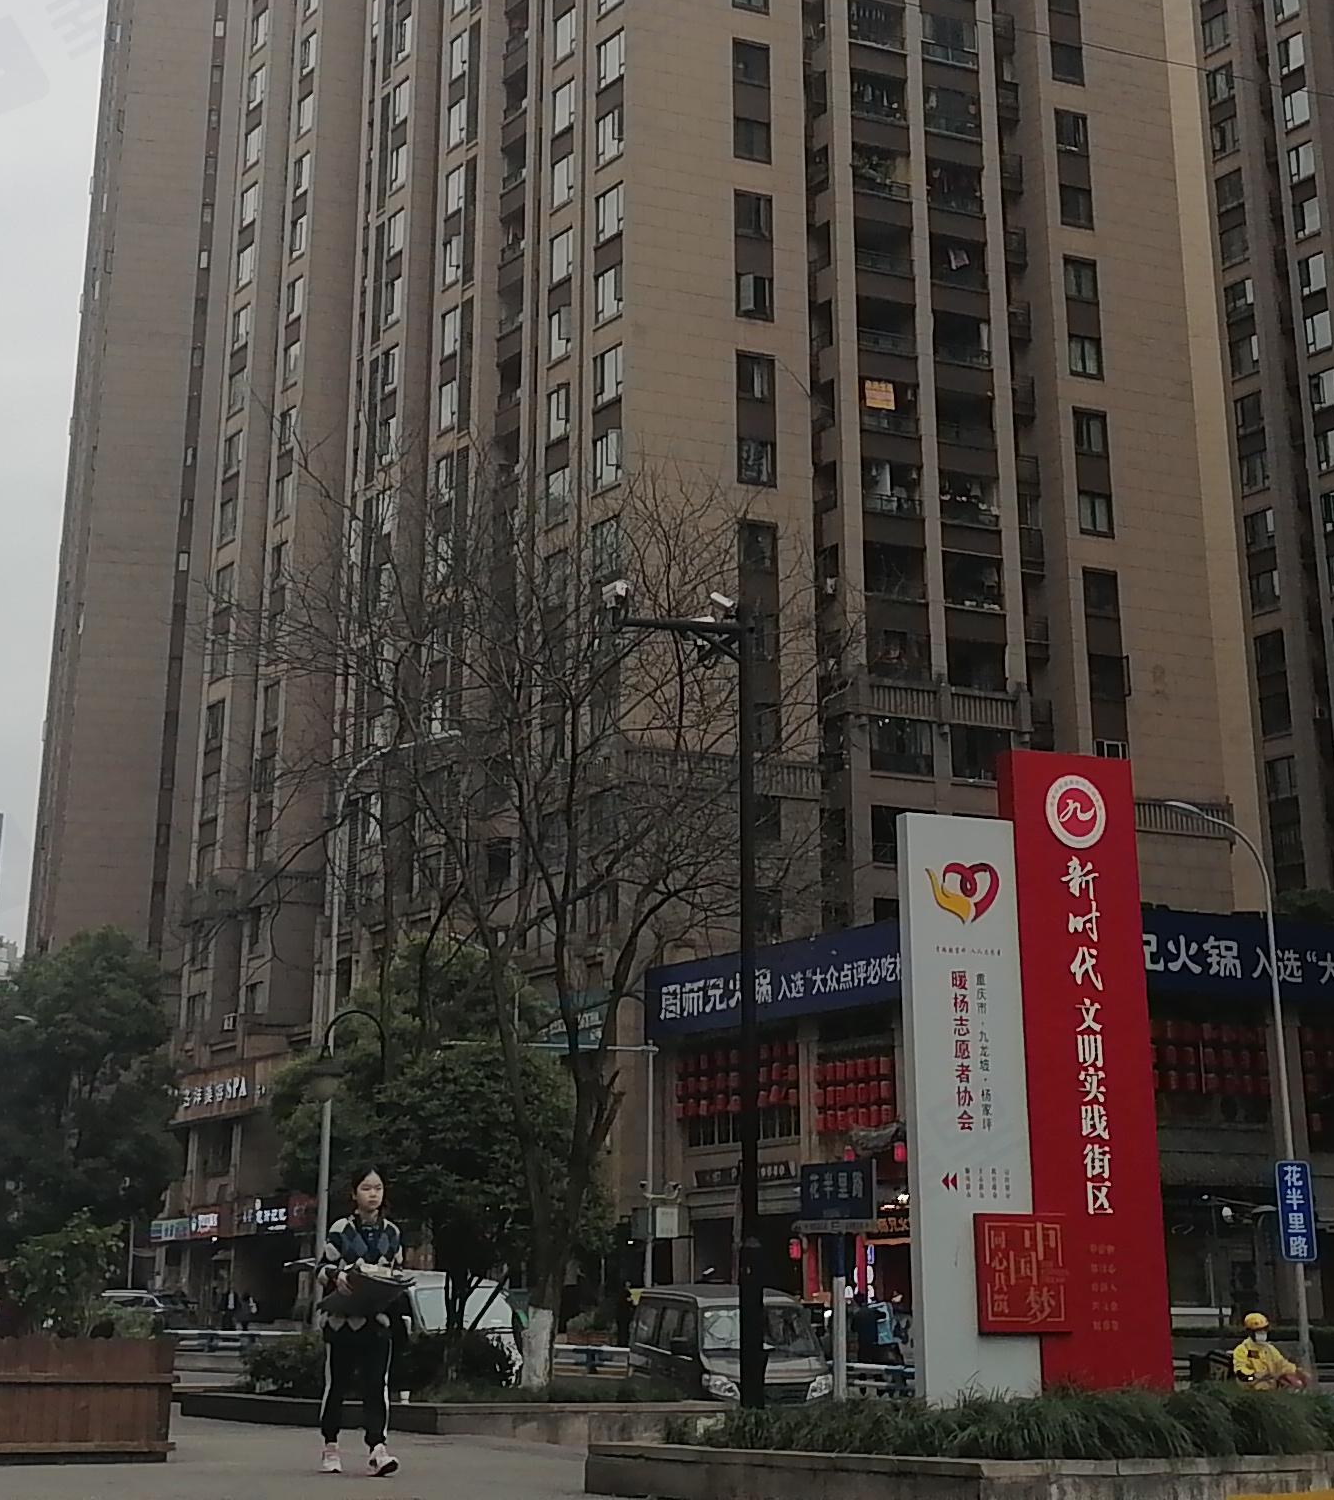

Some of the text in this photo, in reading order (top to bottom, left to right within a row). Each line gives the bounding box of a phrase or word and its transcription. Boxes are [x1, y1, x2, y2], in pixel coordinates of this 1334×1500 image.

[951, 970, 974, 1132] 暖杨志愿者协会
[1060, 855, 1114, 1215] 新时代文明实践街区
[809, 1171, 864, 1200] 花半里路
[1283, 1165, 1308, 1258] 花半里路
